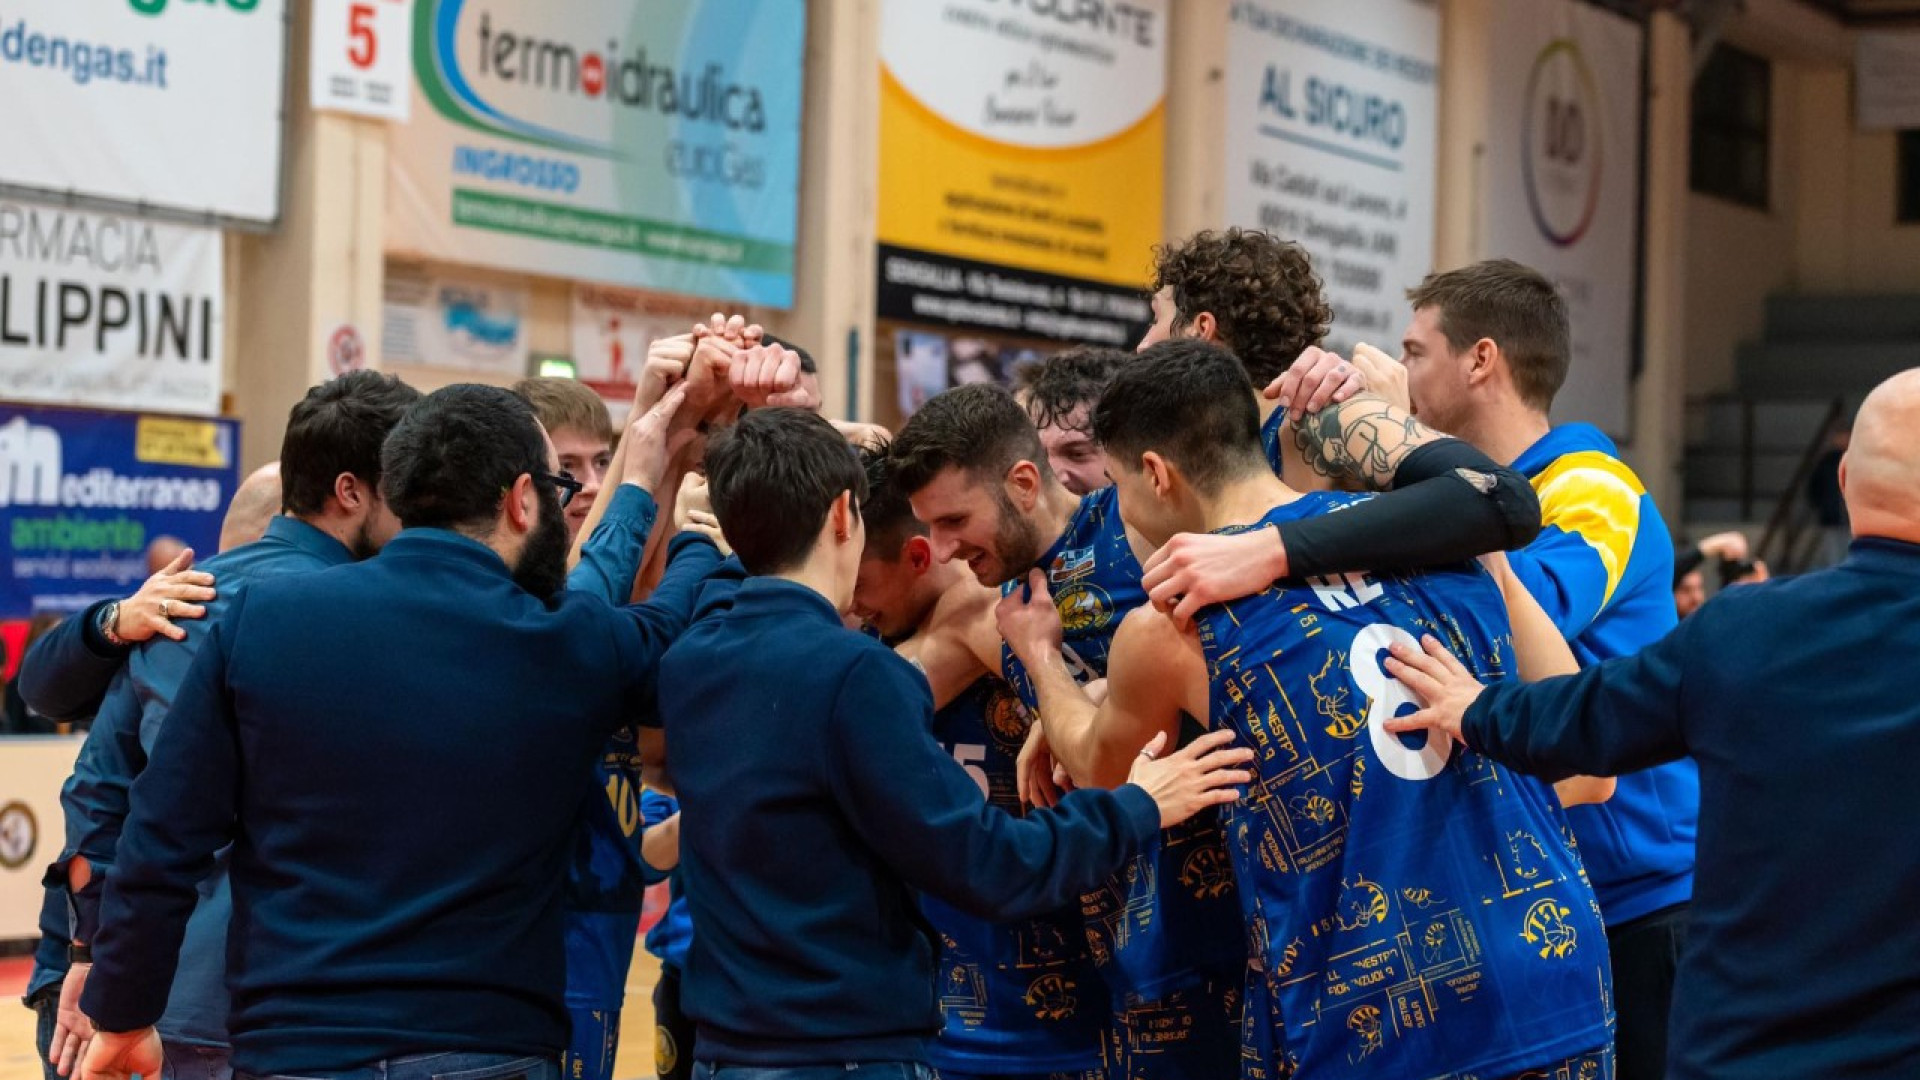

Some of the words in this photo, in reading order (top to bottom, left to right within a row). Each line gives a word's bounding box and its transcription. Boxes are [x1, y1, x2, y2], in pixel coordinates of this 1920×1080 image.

[0, 18, 168, 89] dengas.it
[347, 3, 378, 70] 5
[477, 12, 766, 132] termoidraulica
[1257, 61, 1297, 120] AL
[1303, 75, 1407, 153] SICURO
[452, 144, 580, 194] INGROSSO
[0, 205, 163, 276] RMACIA
[1, 272, 212, 364] LIPPINI
[1350, 624, 1452, 780] 8
